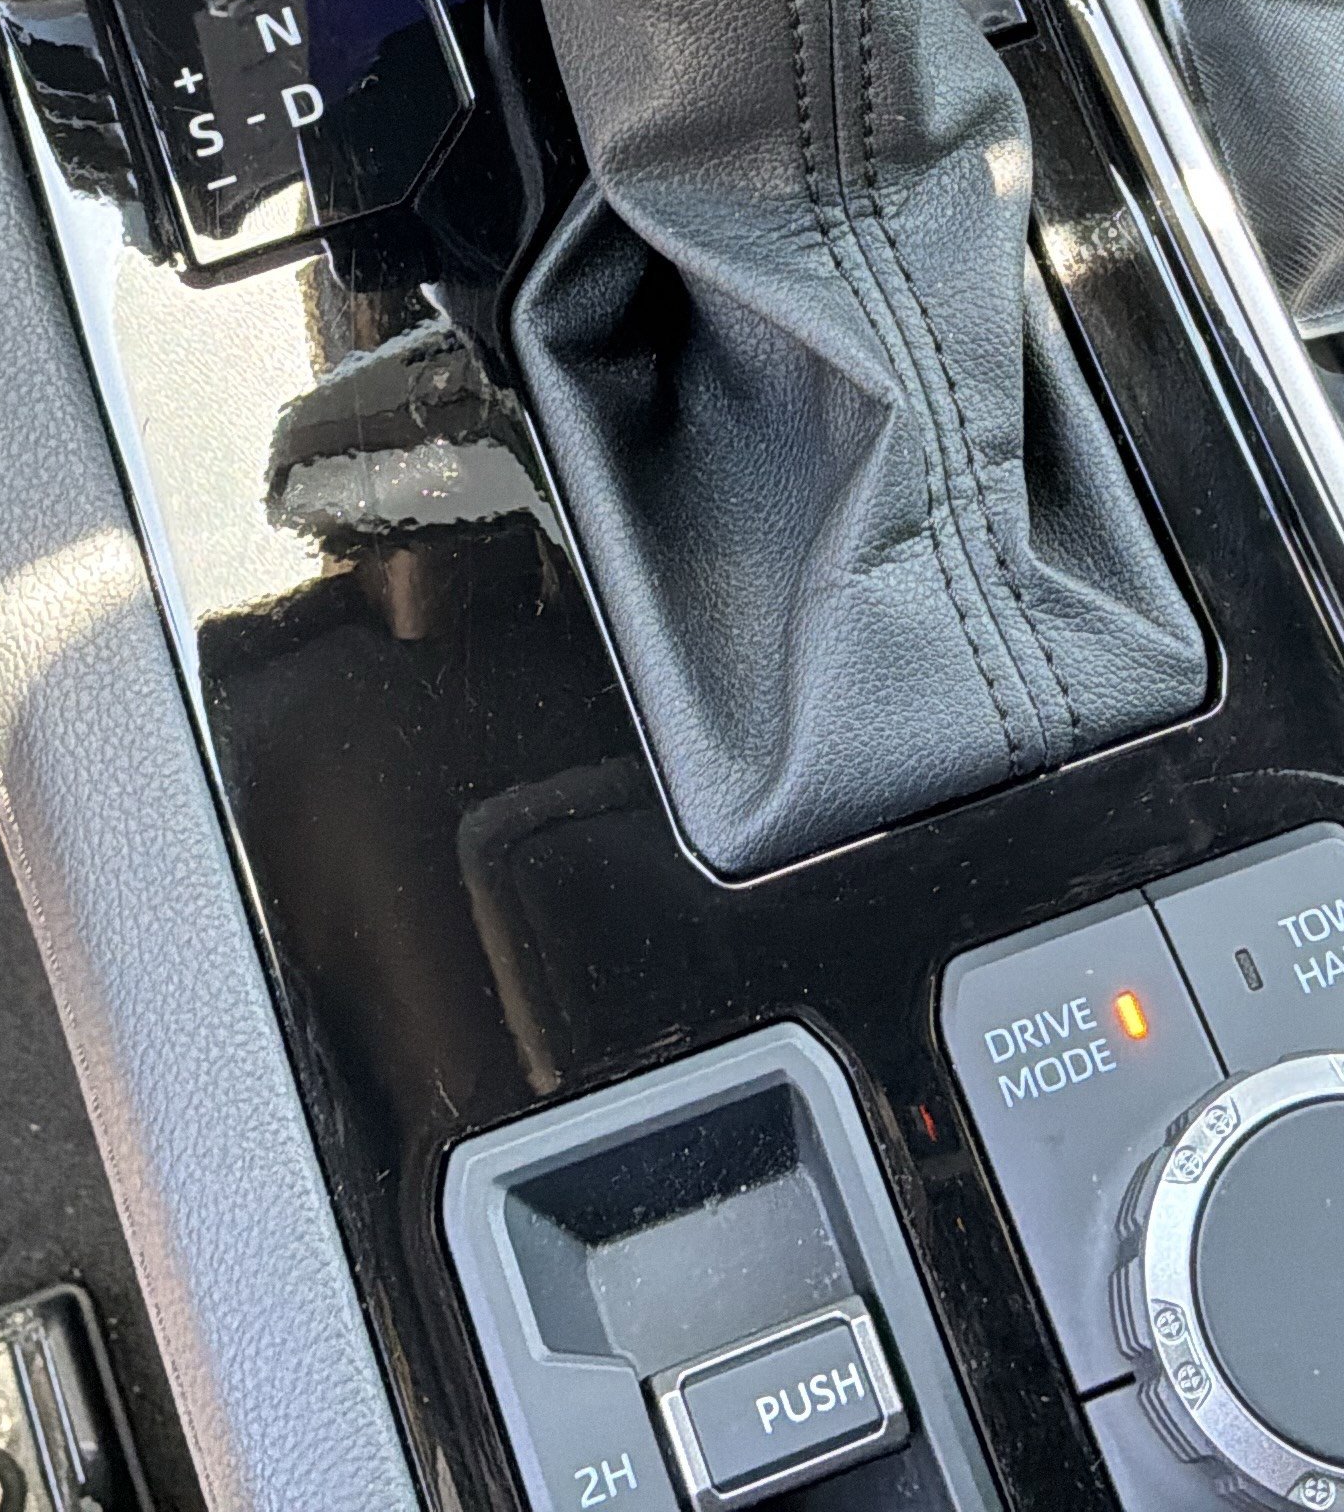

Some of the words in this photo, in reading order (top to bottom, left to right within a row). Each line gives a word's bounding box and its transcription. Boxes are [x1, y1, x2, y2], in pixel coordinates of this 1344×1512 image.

[256, 6, 302, 53] N
[188, 112, 224, 158] S
[281, 83, 324, 128] D
[984, 996, 1098, 1063] DRIVE
[998, 1038, 1117, 1108] MODE
[757, 1363, 865, 1434] PUSH
[574, 1452, 638, 1509] 2H
